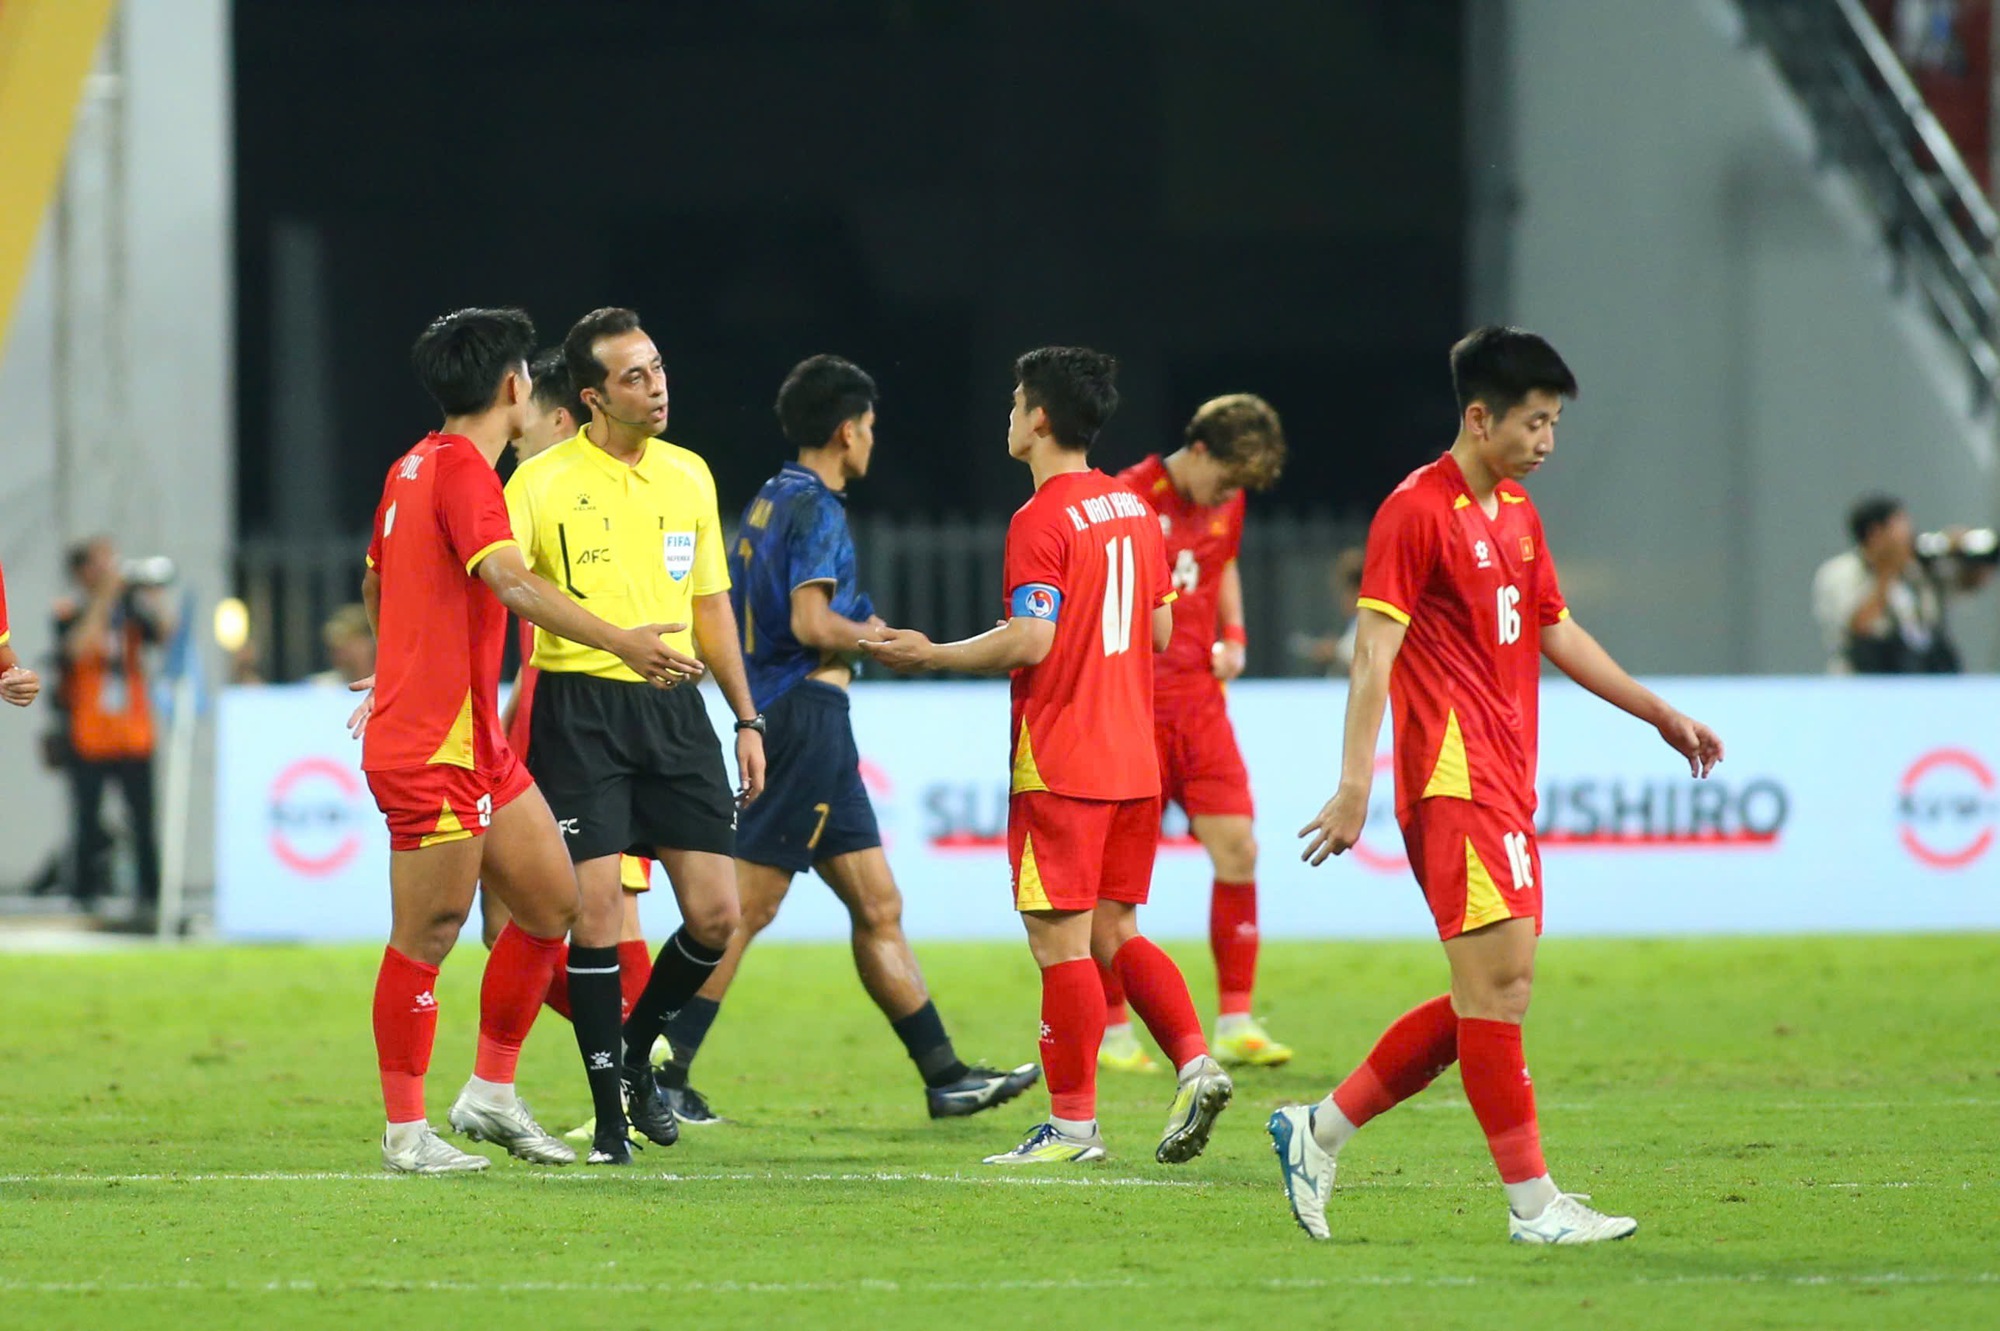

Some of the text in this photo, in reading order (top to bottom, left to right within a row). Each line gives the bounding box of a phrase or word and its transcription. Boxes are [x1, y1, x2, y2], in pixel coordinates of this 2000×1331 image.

[576, 548, 611, 565] AFC
[667, 535, 691, 547] FIFA
[1102, 535, 1135, 657] 11
[1496, 585, 1521, 646] 16
[558, 817, 580, 836] FC
[807, 802, 829, 849] 7
[1537, 780, 1789, 834] SHIRO
